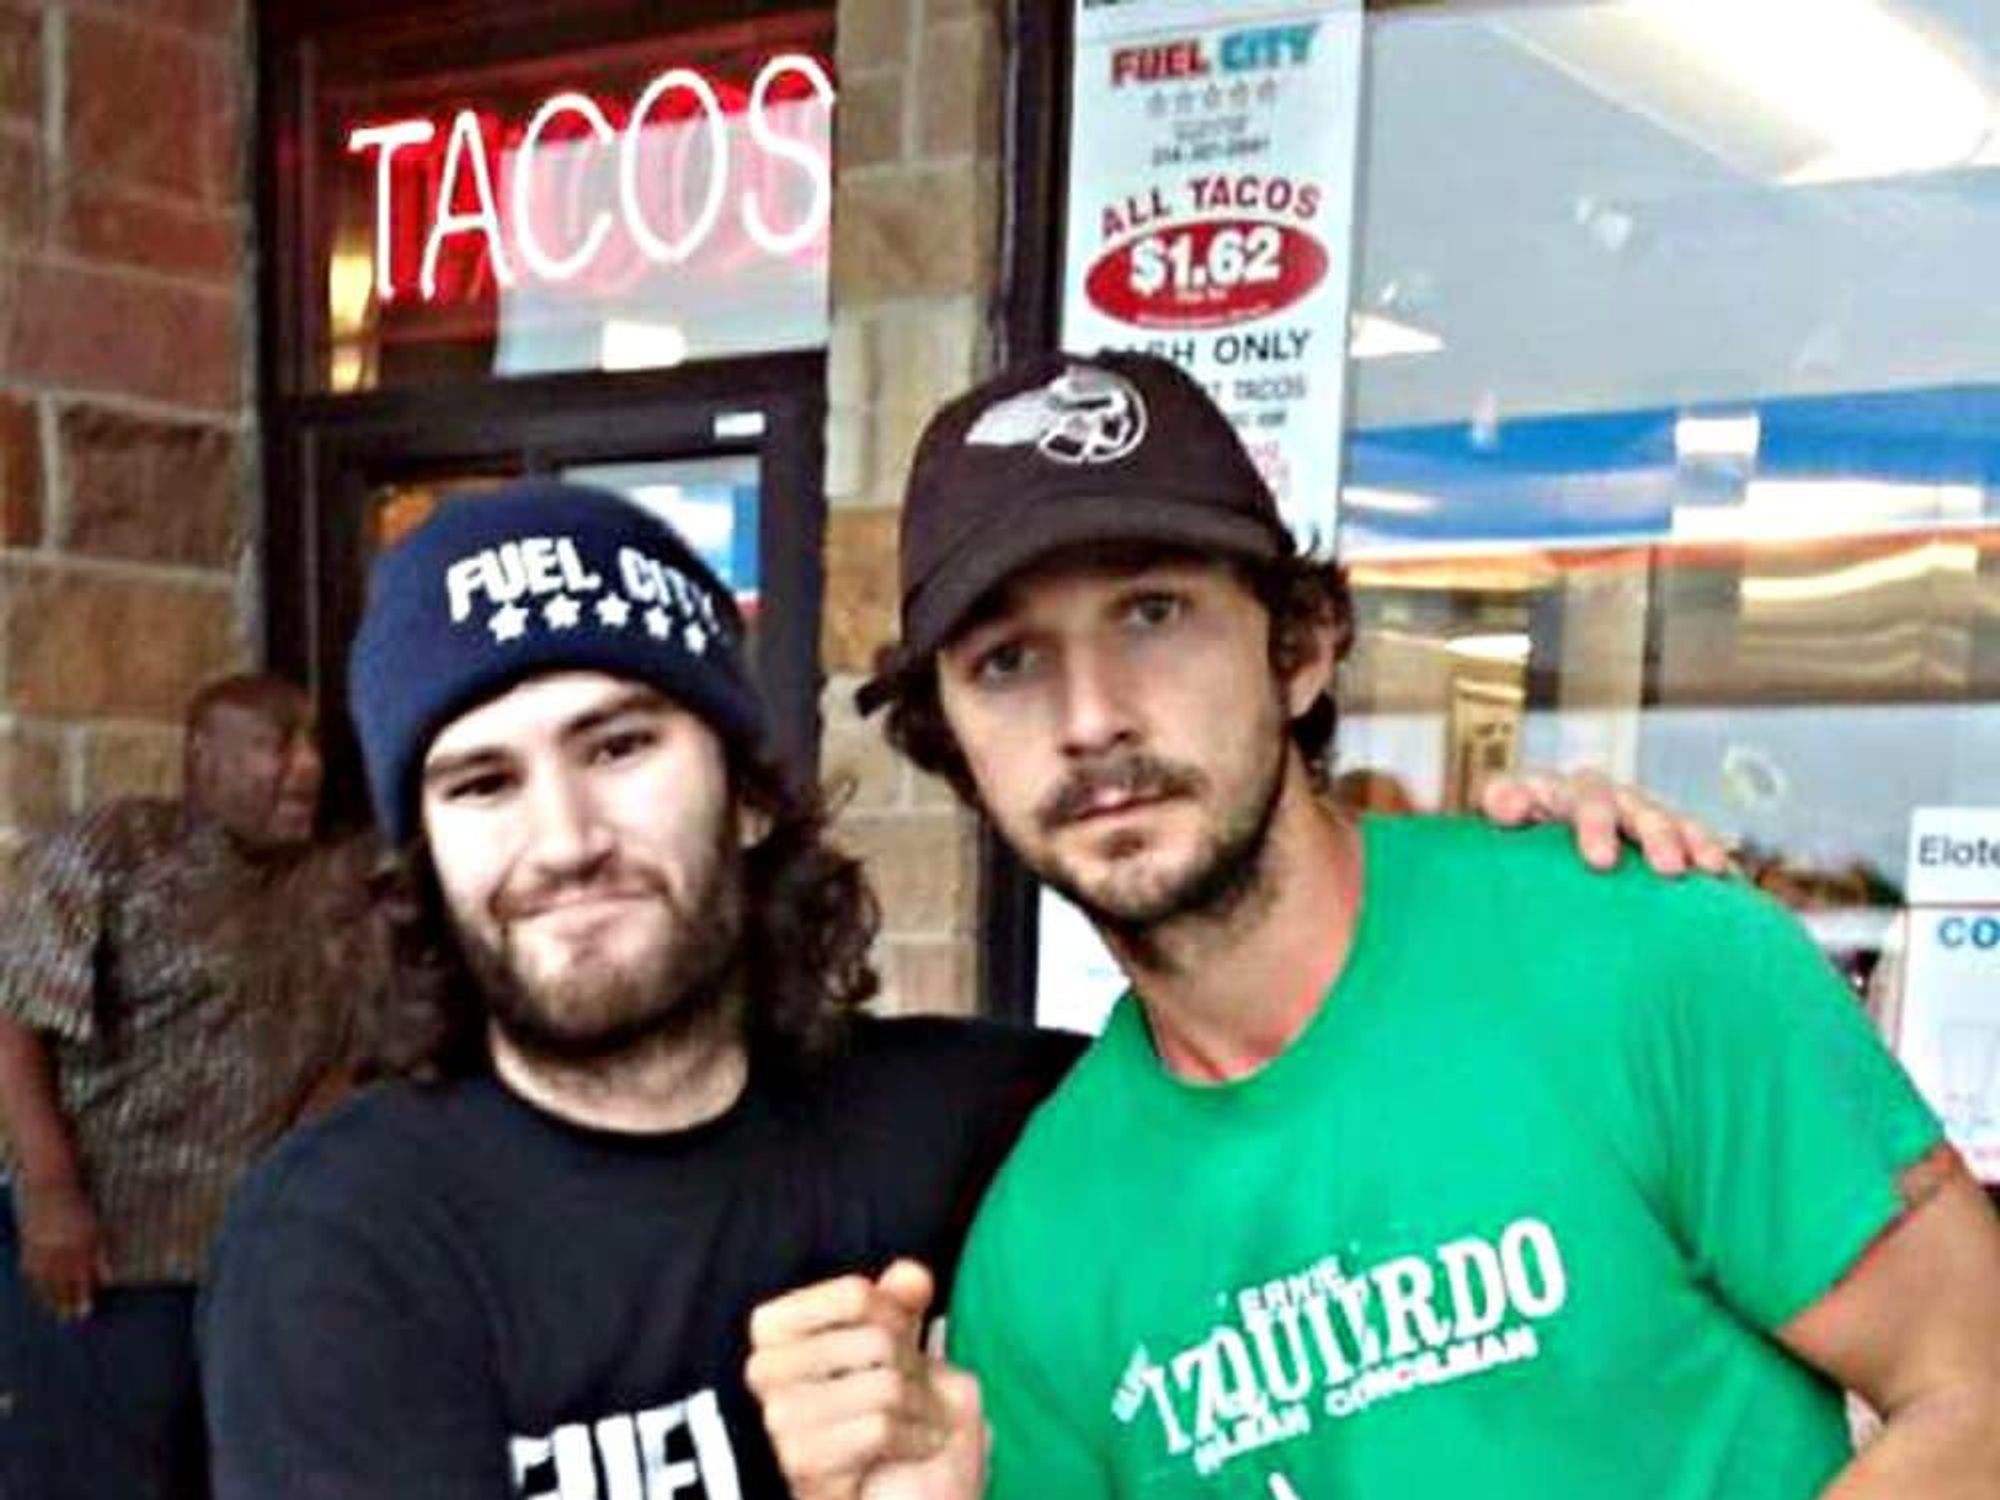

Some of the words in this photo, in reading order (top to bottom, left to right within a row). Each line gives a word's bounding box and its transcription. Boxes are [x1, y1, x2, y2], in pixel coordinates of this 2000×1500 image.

[1111, 40, 1210, 86] FUEL
[1220, 22, 1319, 72] CITY
[348, 54, 836, 302] TACOS
[1101, 186, 1170, 236] ALL
[1187, 175, 1321, 219] TACOS
[1128, 226, 1282, 296] $1.62
[1213, 327, 1312, 365] ONLY
[446, 536, 601, 622] FUEL
